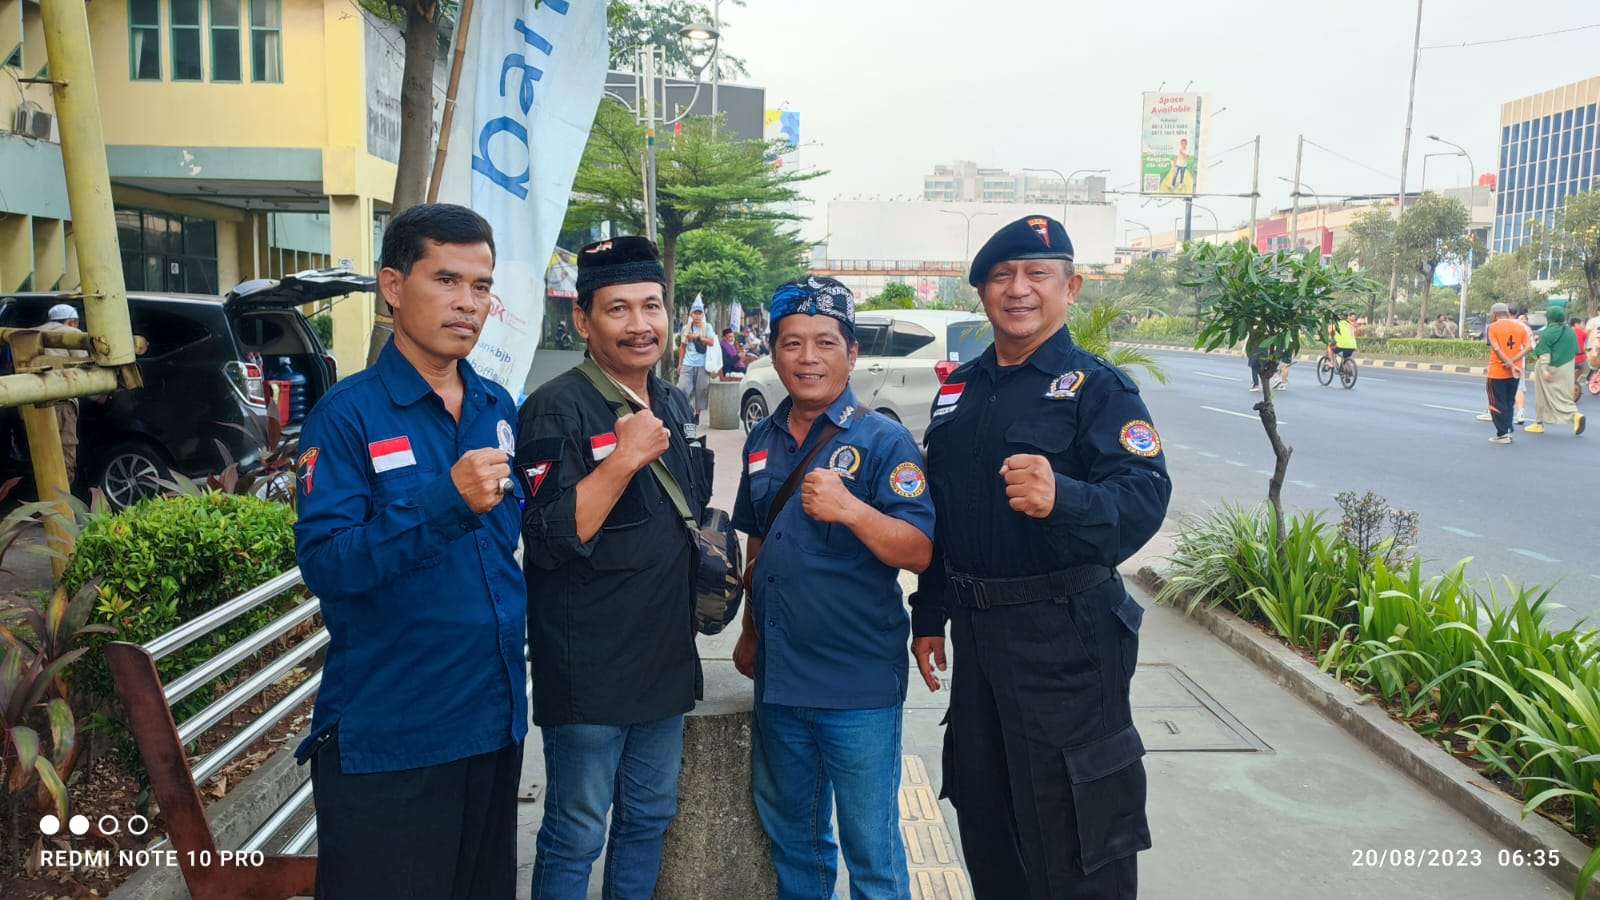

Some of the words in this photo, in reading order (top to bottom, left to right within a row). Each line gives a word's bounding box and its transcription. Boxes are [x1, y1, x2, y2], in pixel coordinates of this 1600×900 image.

[1159, 96, 1184, 105] Space
[1151, 105, 1191, 114] Available
[1506, 334, 1515, 350] 4
